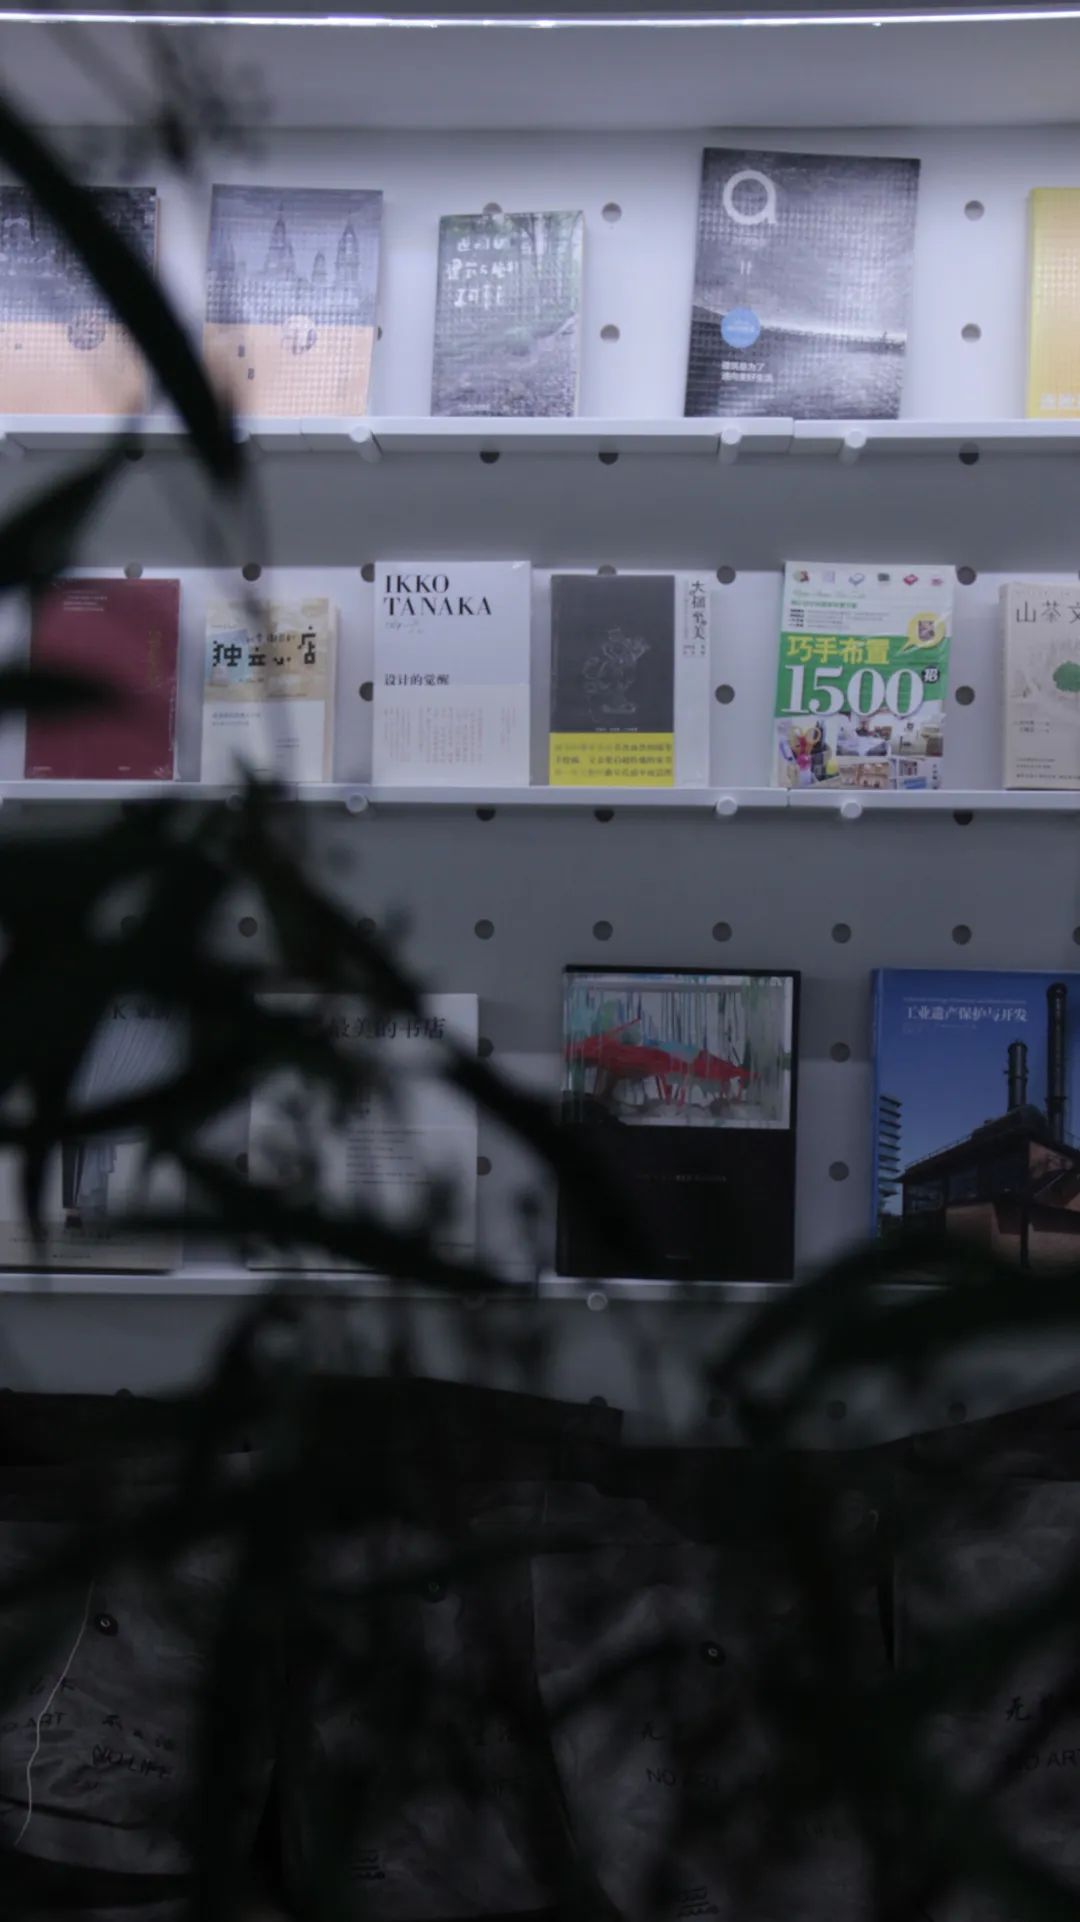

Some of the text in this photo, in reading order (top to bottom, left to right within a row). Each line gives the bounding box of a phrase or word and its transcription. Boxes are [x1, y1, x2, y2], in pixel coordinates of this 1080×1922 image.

[385, 574, 450, 594] IKKO
[383, 596, 493, 617] TANAKA
[786, 636, 891, 665] 巧手布置
[383, 673, 450, 687] 设计的觉醒
[780, 664, 925, 717] 1500
[905, 1005, 1028, 1023] 工业遗产保护与开发
